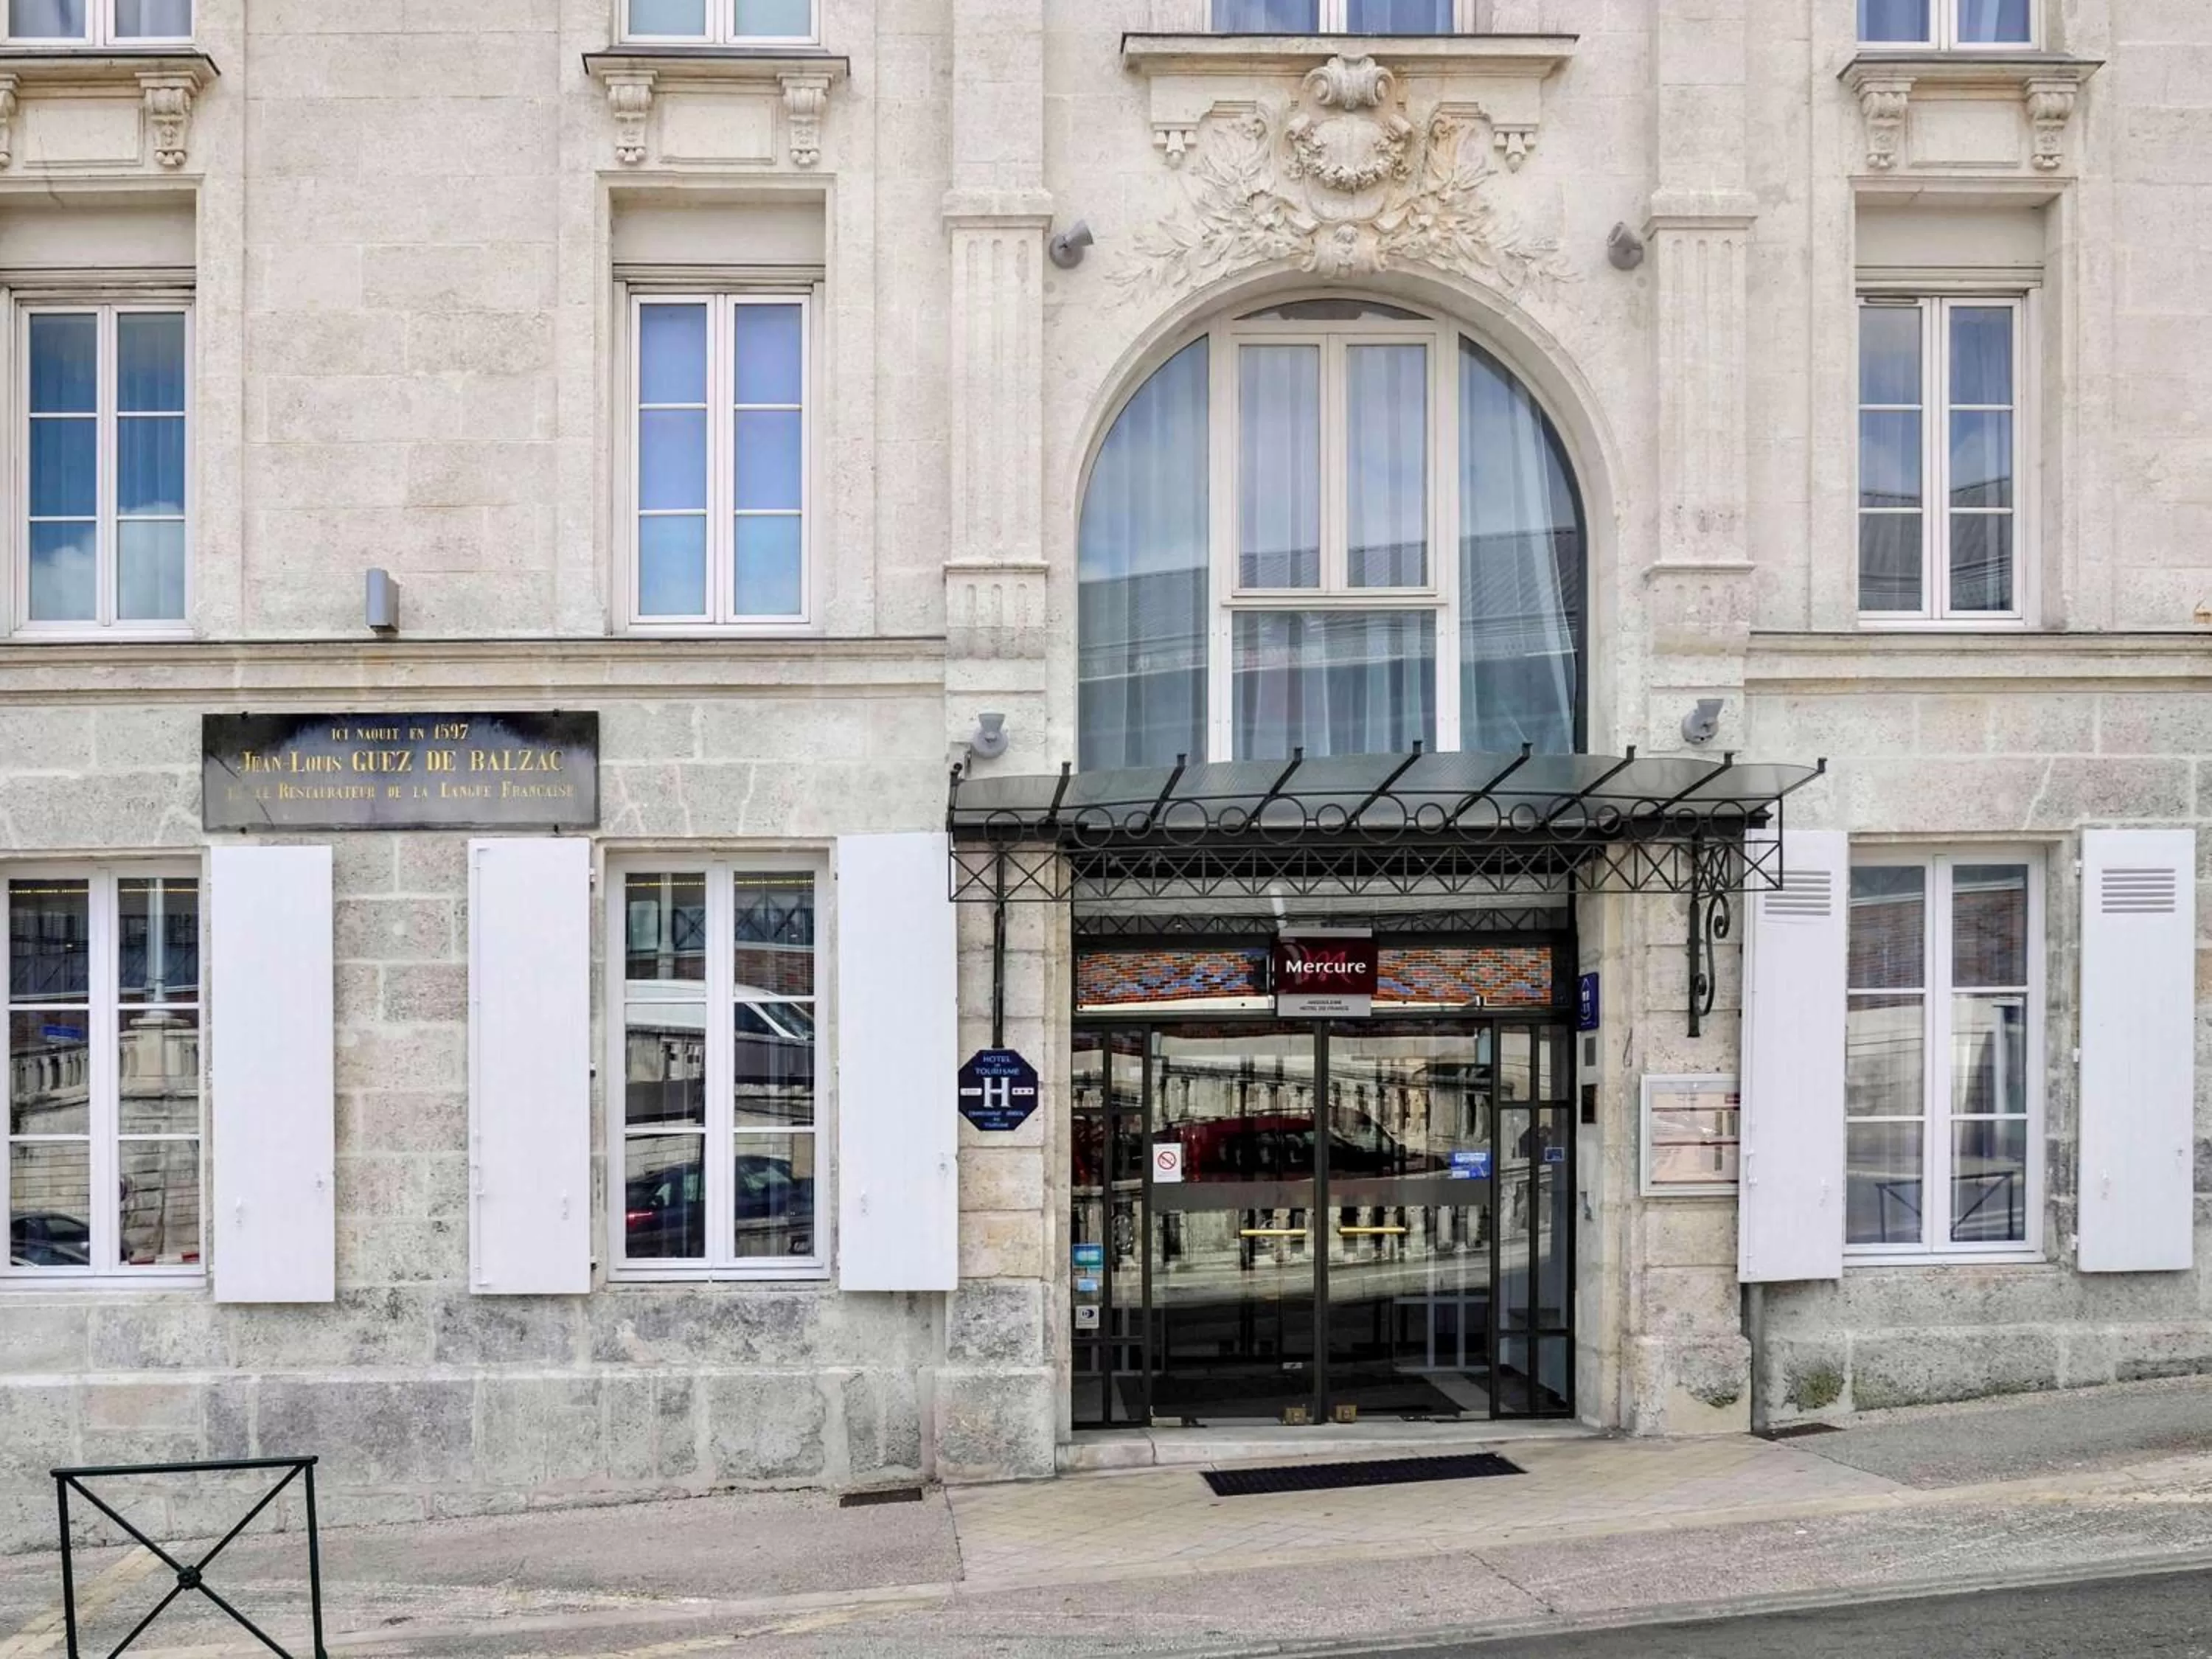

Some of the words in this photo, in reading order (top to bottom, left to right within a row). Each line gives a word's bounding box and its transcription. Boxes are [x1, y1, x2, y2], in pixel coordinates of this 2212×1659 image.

[331, 728, 349, 740] ICI
[357, 727, 400, 742] NAQUIT
[409, 727, 424, 740] EN
[434, 723, 469, 740] 1597
[352, 750, 413, 773] GUEZ
[426, 750, 456, 771] DE
[469, 749, 565, 771] BALZAC
[413, 785, 428, 799] LA
[440, 782, 491, 799] LANGUE
[1285, 959, 1366, 974] Mercure
[984, 1077, 1010, 1107] H
